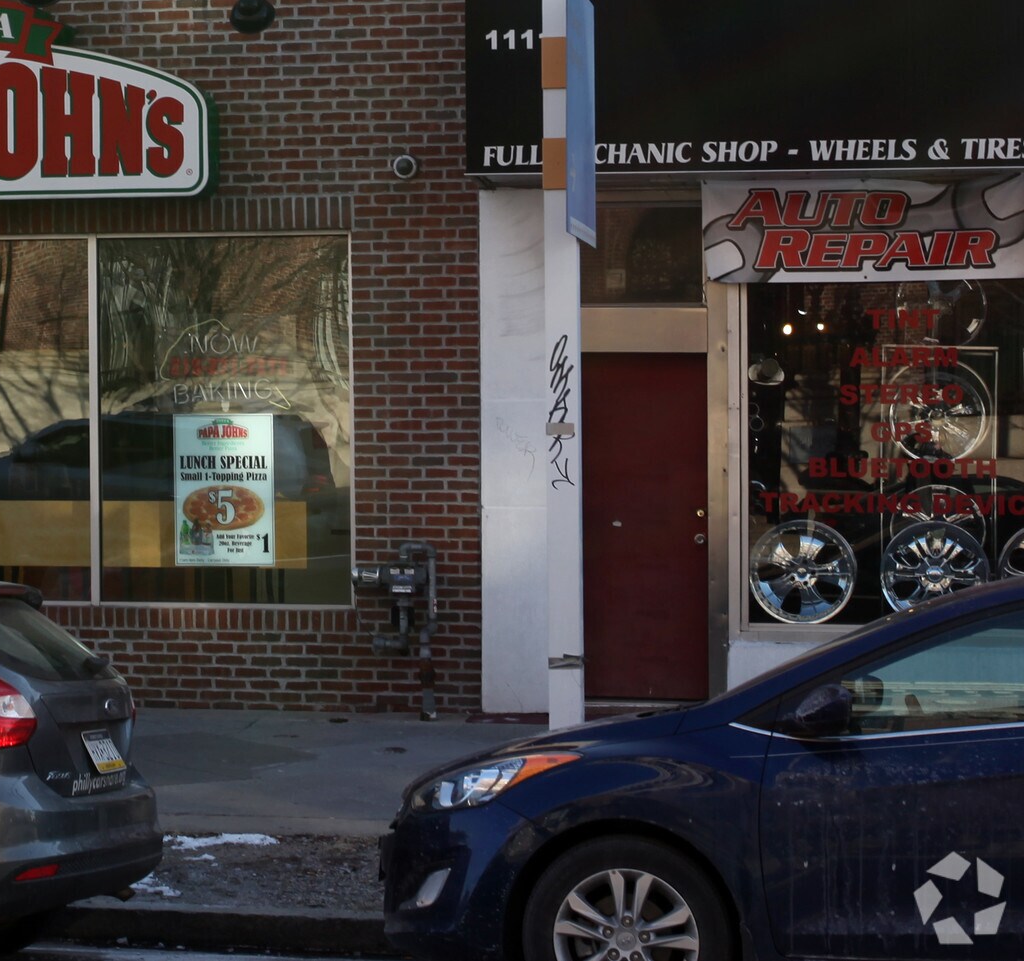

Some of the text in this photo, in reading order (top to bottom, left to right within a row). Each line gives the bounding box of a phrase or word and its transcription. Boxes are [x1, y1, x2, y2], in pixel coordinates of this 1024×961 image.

[483, 144, 543, 167] FULL
[702, 141, 778, 163] SHOP
[810, 138, 917, 162] WHEELS
[928, 138, 950, 160] &
[960, 137, 1024, 160] TIRE
[729, 189, 907, 228] AUTO
[754, 229, 997, 270] REPAIR
[866, 309, 940, 329] TINT
[190, 333, 258, 354] NOW
[850, 347, 959, 368] ALARM
[173, 378, 273, 404] BAKING
[840, 384, 964, 406] STEREO
[871, 422, 934, 443] GPS
[179, 455, 268, 470] LUNCH SPECIAL
[808, 458, 997, 479] BLUETOOTH
[180, 472, 267, 483] Small 1-Topping Pizza
[208, 489, 236, 525] $5
[759, 492, 923, 515] TRACKING
